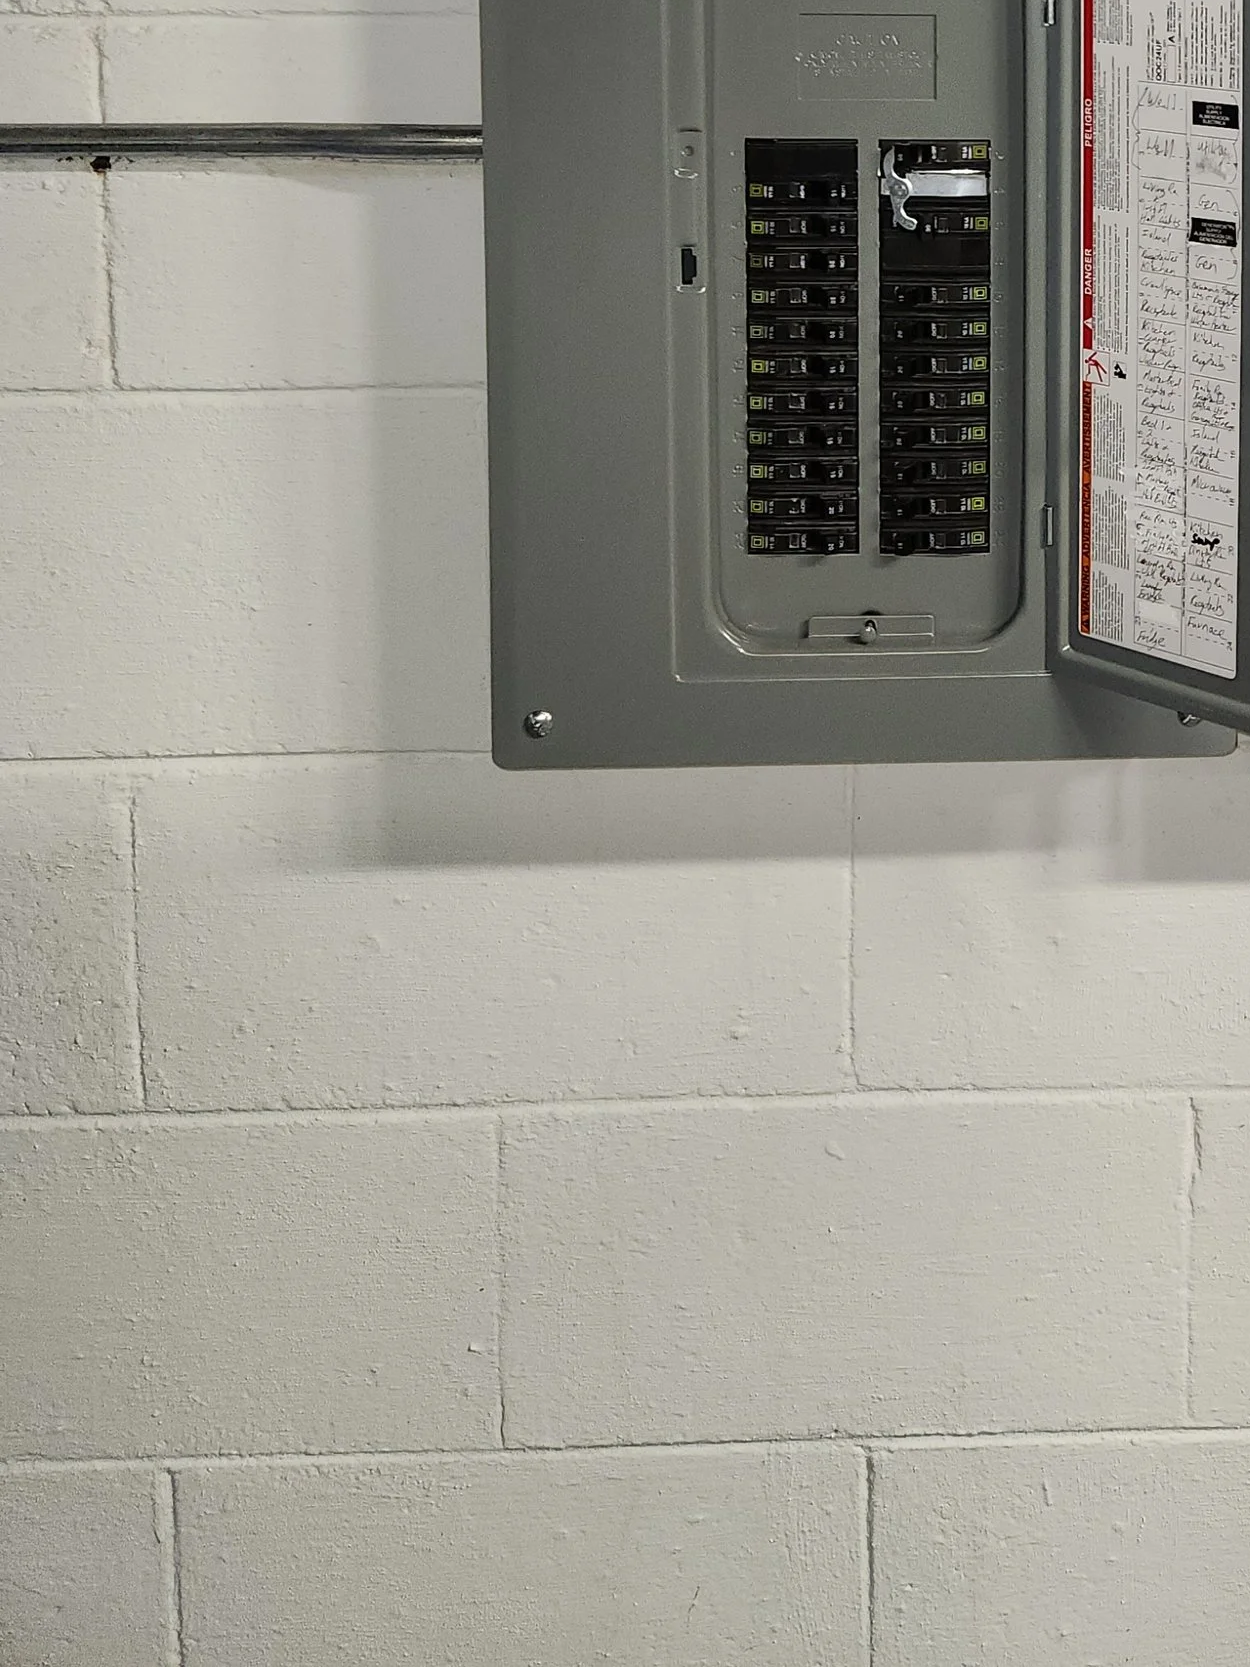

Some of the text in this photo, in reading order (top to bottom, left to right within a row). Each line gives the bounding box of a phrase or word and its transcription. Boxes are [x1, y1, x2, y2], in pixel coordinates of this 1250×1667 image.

[1147, 90, 1177, 111] Well
[1084, 98, 1093, 147] PELIGRO
[1147, 136, 1175, 159] Well
[1084, 248, 1093, 295] DANGER
[1196, 256, 1217, 274] Gen
[1083, 382, 1092, 475] AVERTISSEMENT
[1083, 482, 1091, 558] ADVERTENCIA
[1082, 565, 1090, 616] WARNING
[1137, 626, 1167, 651] Fridge
[1187, 615, 1228, 640] Furnace
